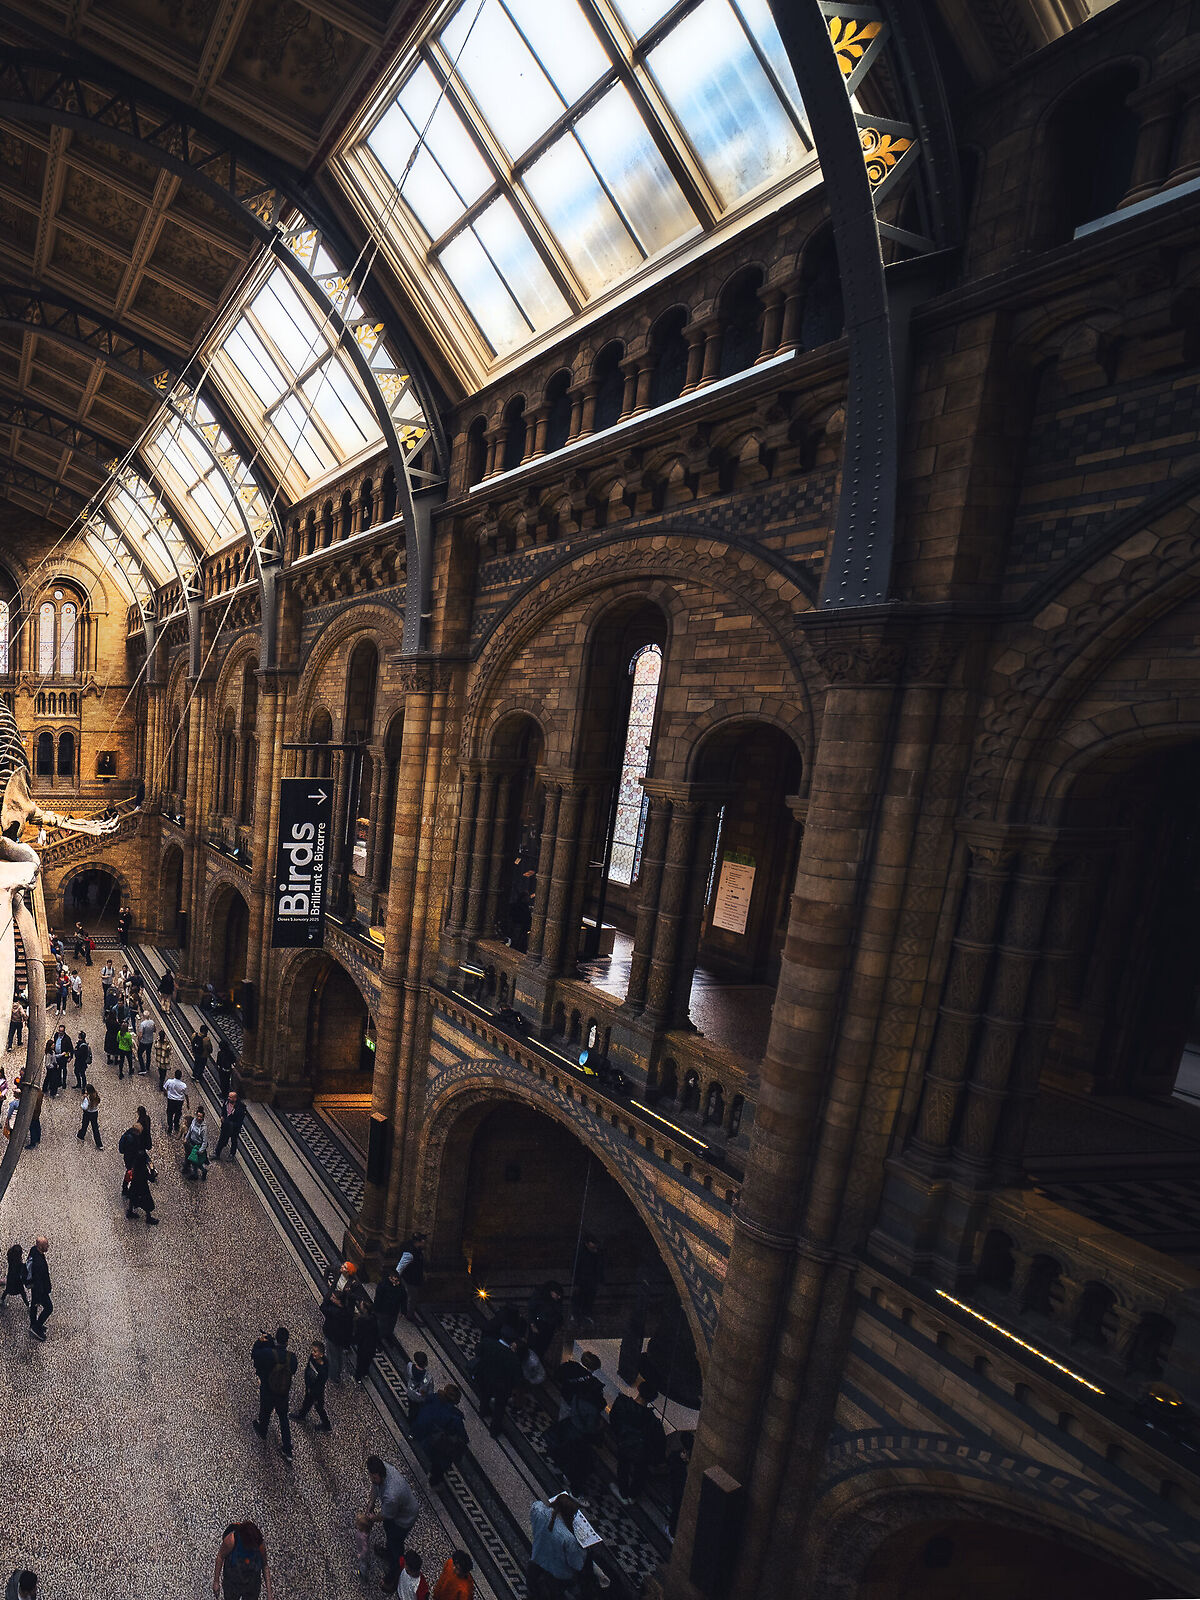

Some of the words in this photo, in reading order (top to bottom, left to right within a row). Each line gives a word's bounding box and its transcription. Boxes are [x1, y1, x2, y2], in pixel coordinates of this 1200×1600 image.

[314, 822, 326, 861] Bizarre
[279, 823, 315, 915] Birds
[314, 863, 323, 872] &
[311, 873, 323, 915] Brilliant
